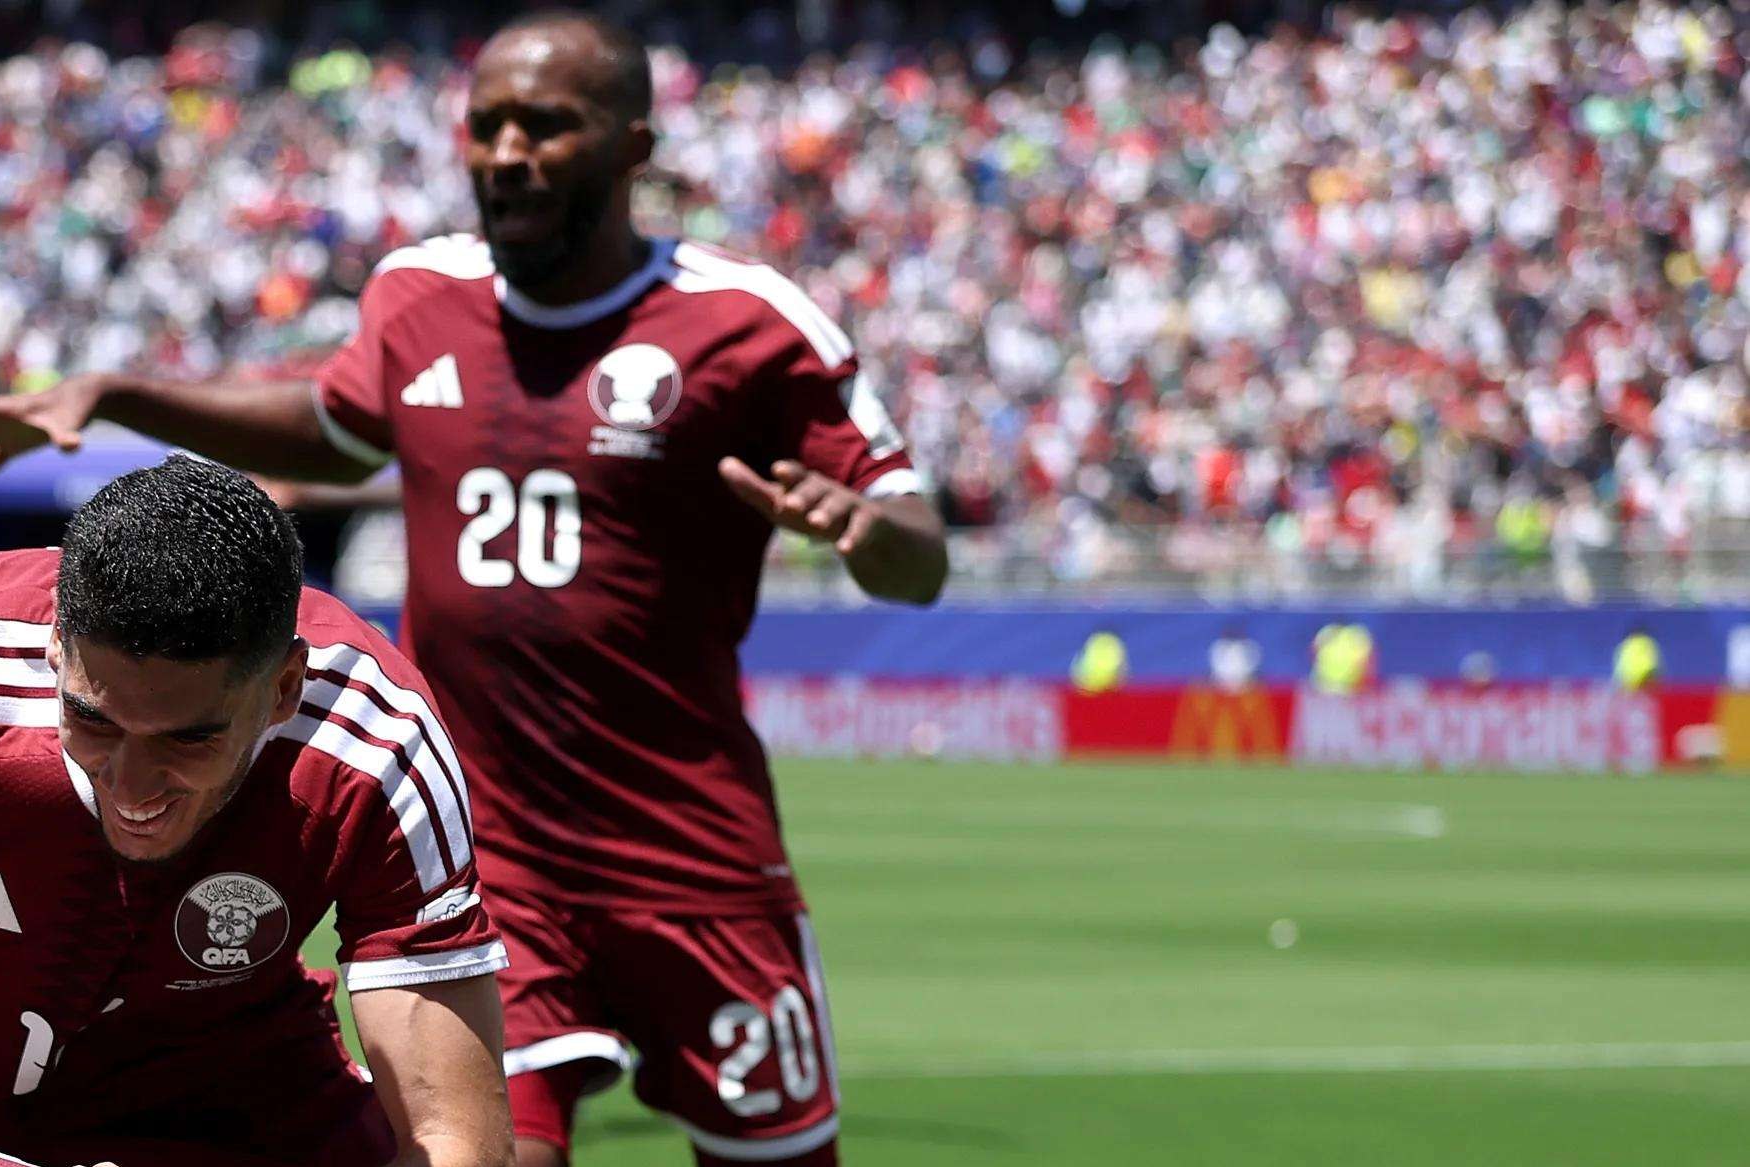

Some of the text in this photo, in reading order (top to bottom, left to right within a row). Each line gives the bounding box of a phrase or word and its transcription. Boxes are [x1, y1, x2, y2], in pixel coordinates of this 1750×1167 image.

[456, 466, 583, 588] 20
[201, 946, 252, 966] QFA
[708, 983, 820, 1118] 20
